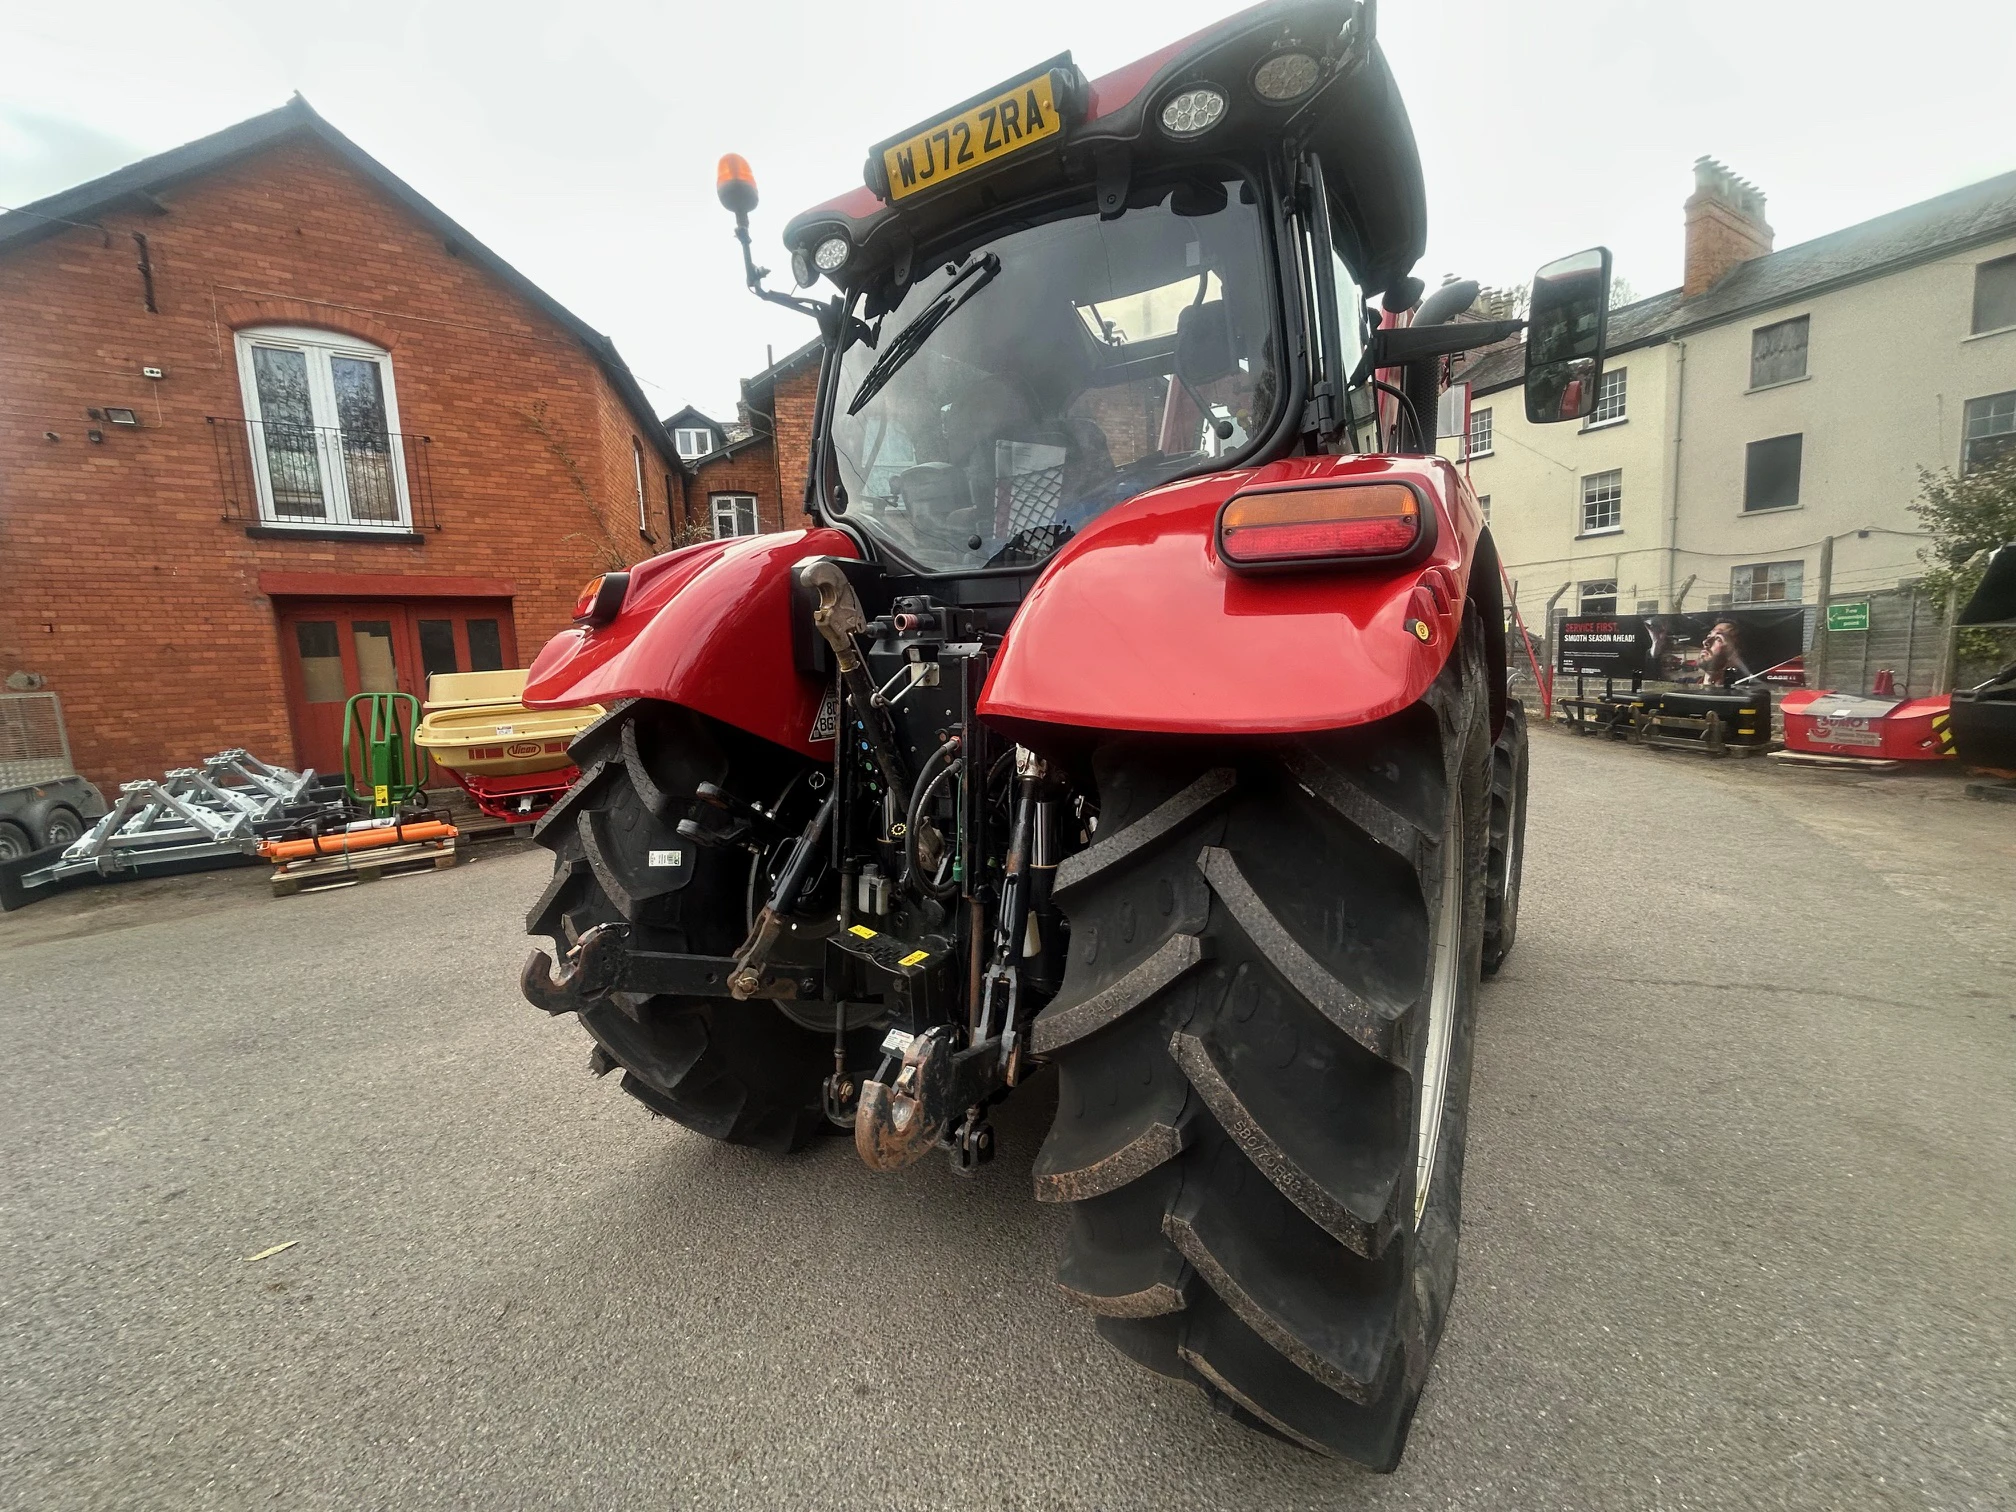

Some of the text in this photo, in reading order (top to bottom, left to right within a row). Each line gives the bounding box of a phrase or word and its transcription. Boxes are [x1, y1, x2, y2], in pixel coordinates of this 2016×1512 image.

[897, 89, 1045, 188] WJ72 ZRA
[1565, 622, 1594, 633] SERVICE
[1564, 634, 1635, 642] SMOOTH SEASON AHEAD!
[820, 717, 836, 731] BG
[511, 743, 537, 755] Vicon
